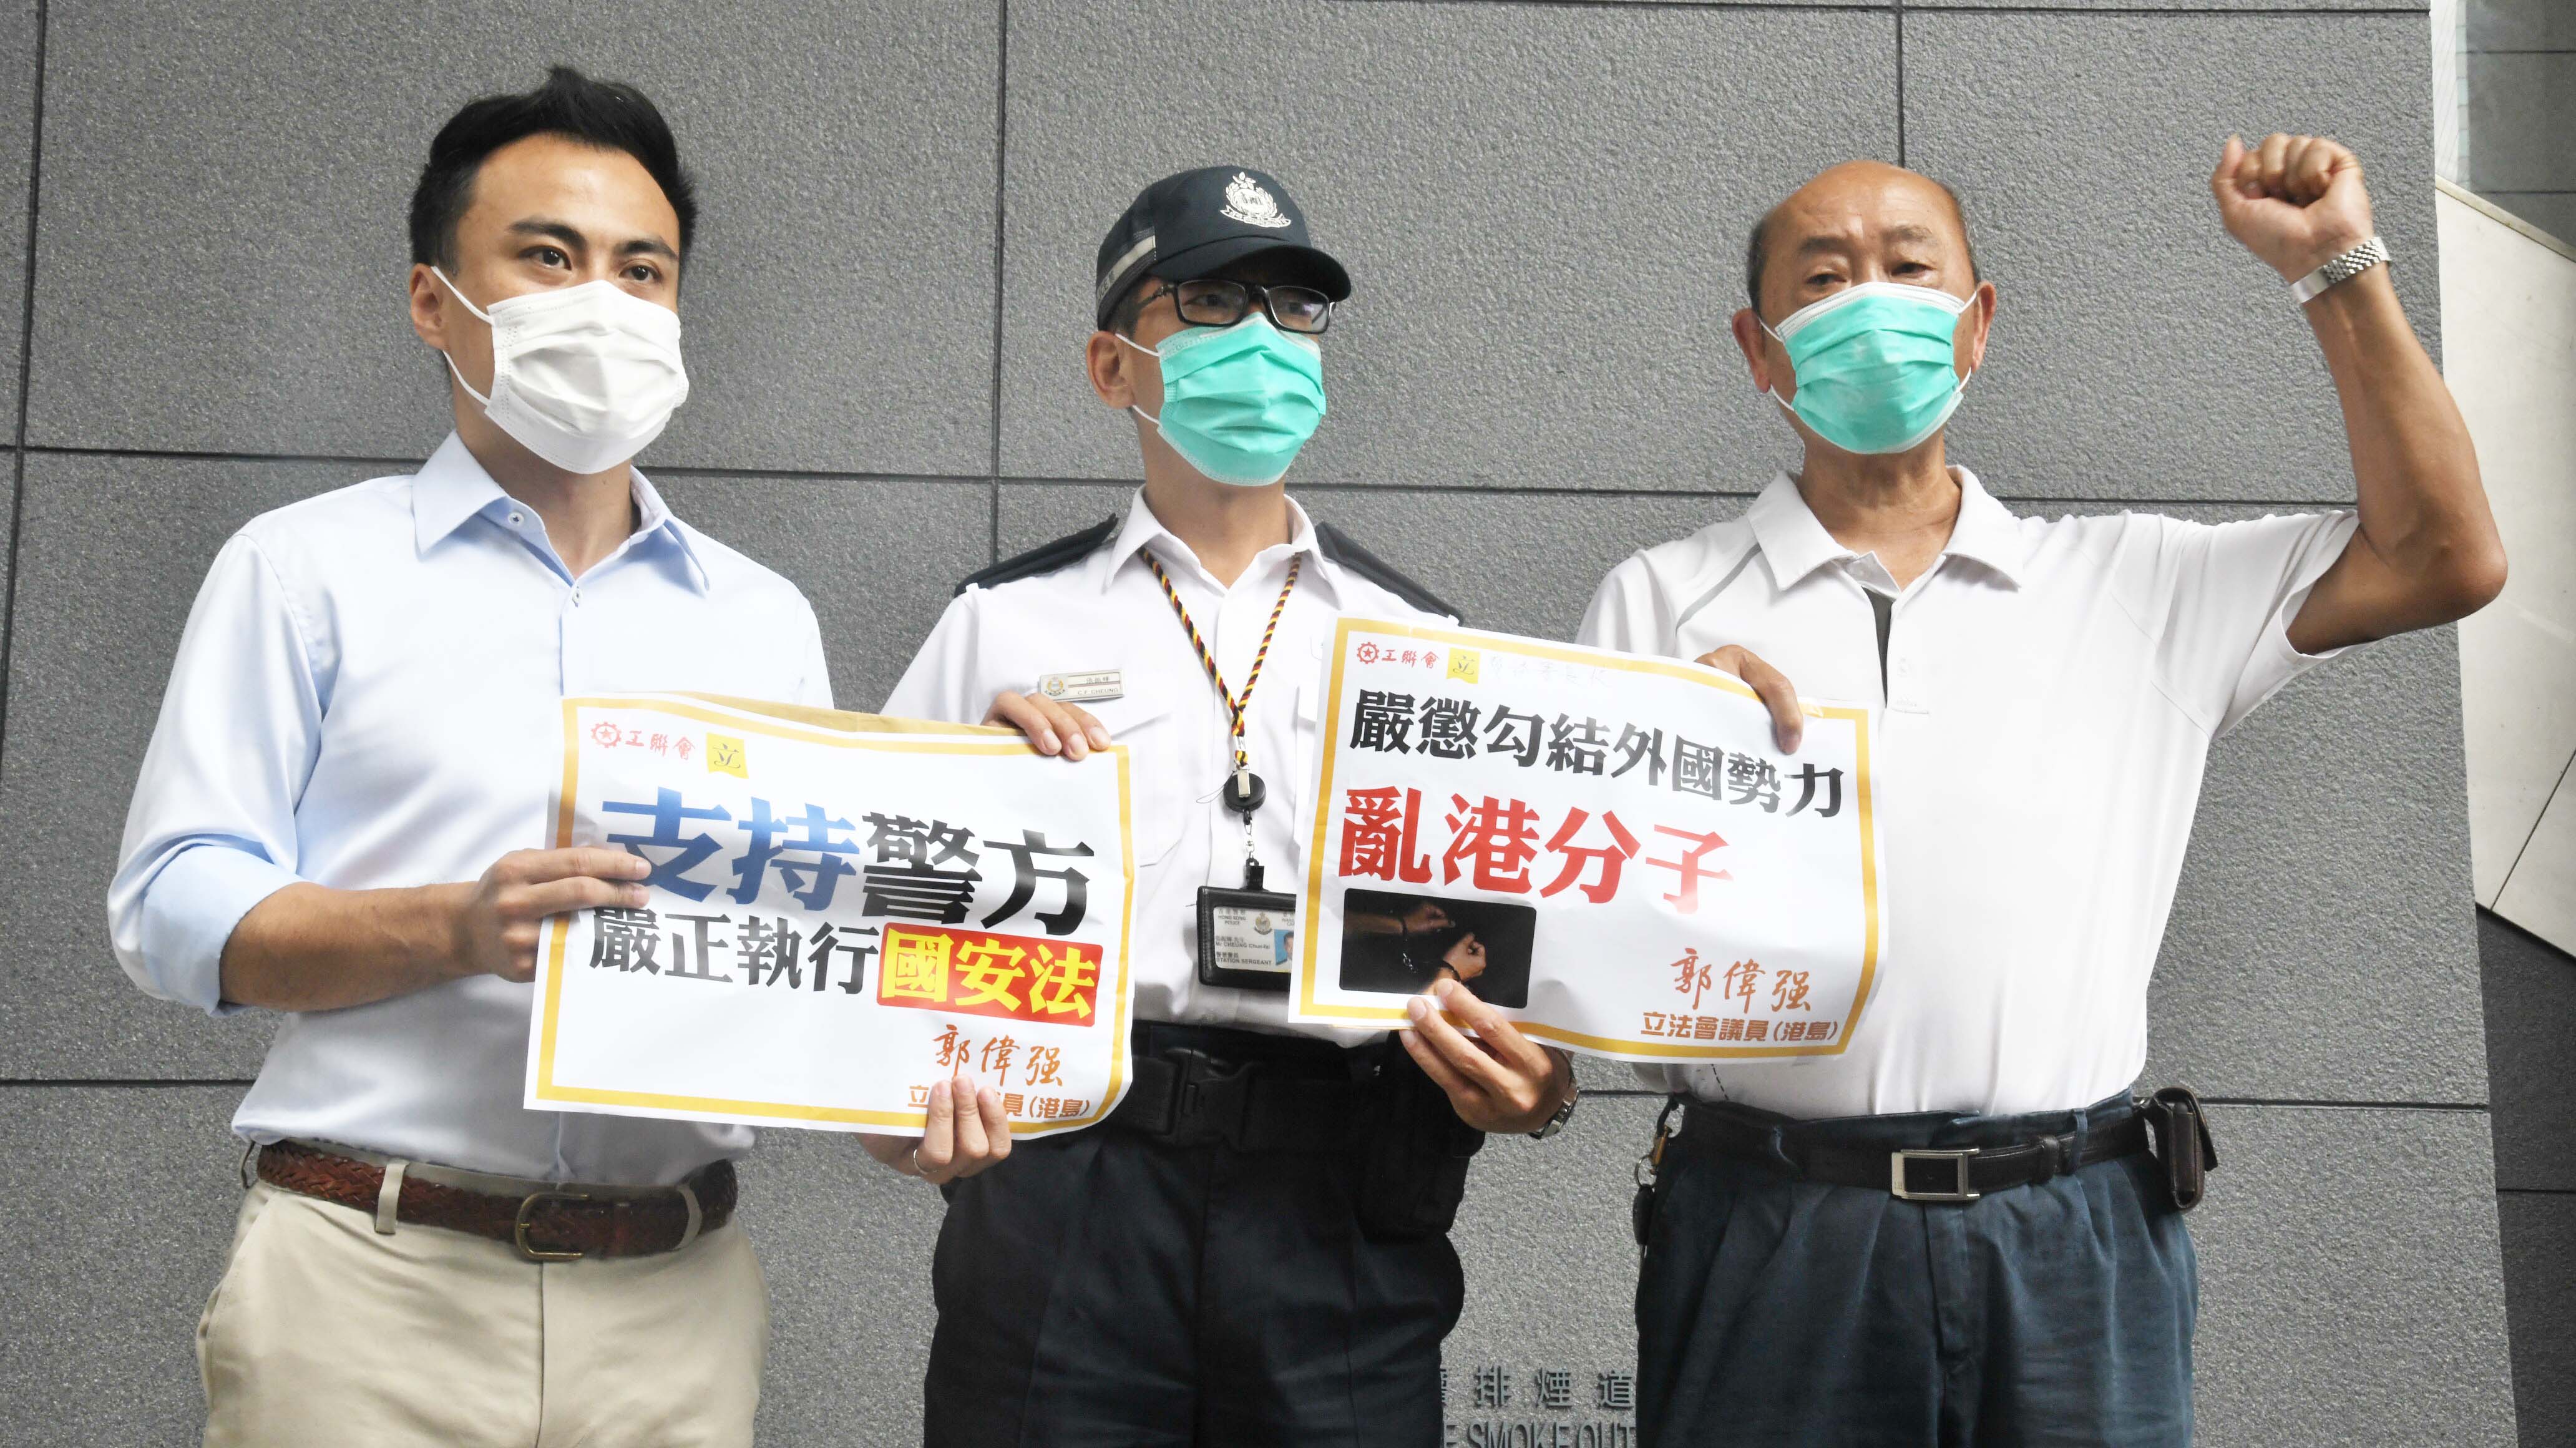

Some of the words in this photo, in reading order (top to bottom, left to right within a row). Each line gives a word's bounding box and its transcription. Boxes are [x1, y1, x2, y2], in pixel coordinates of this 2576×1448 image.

[1382, 649, 1440, 668] 工聯會
[1452, 655, 1475, 675] 立
[625, 730, 695, 760] 工聯會
[713, 743, 741, 769] 立
[1350, 689, 1844, 818] 嚴懲勾結外國勢力
[603, 786, 1095, 936] 支持警方
[1339, 785, 1735, 916] 亂港分子
